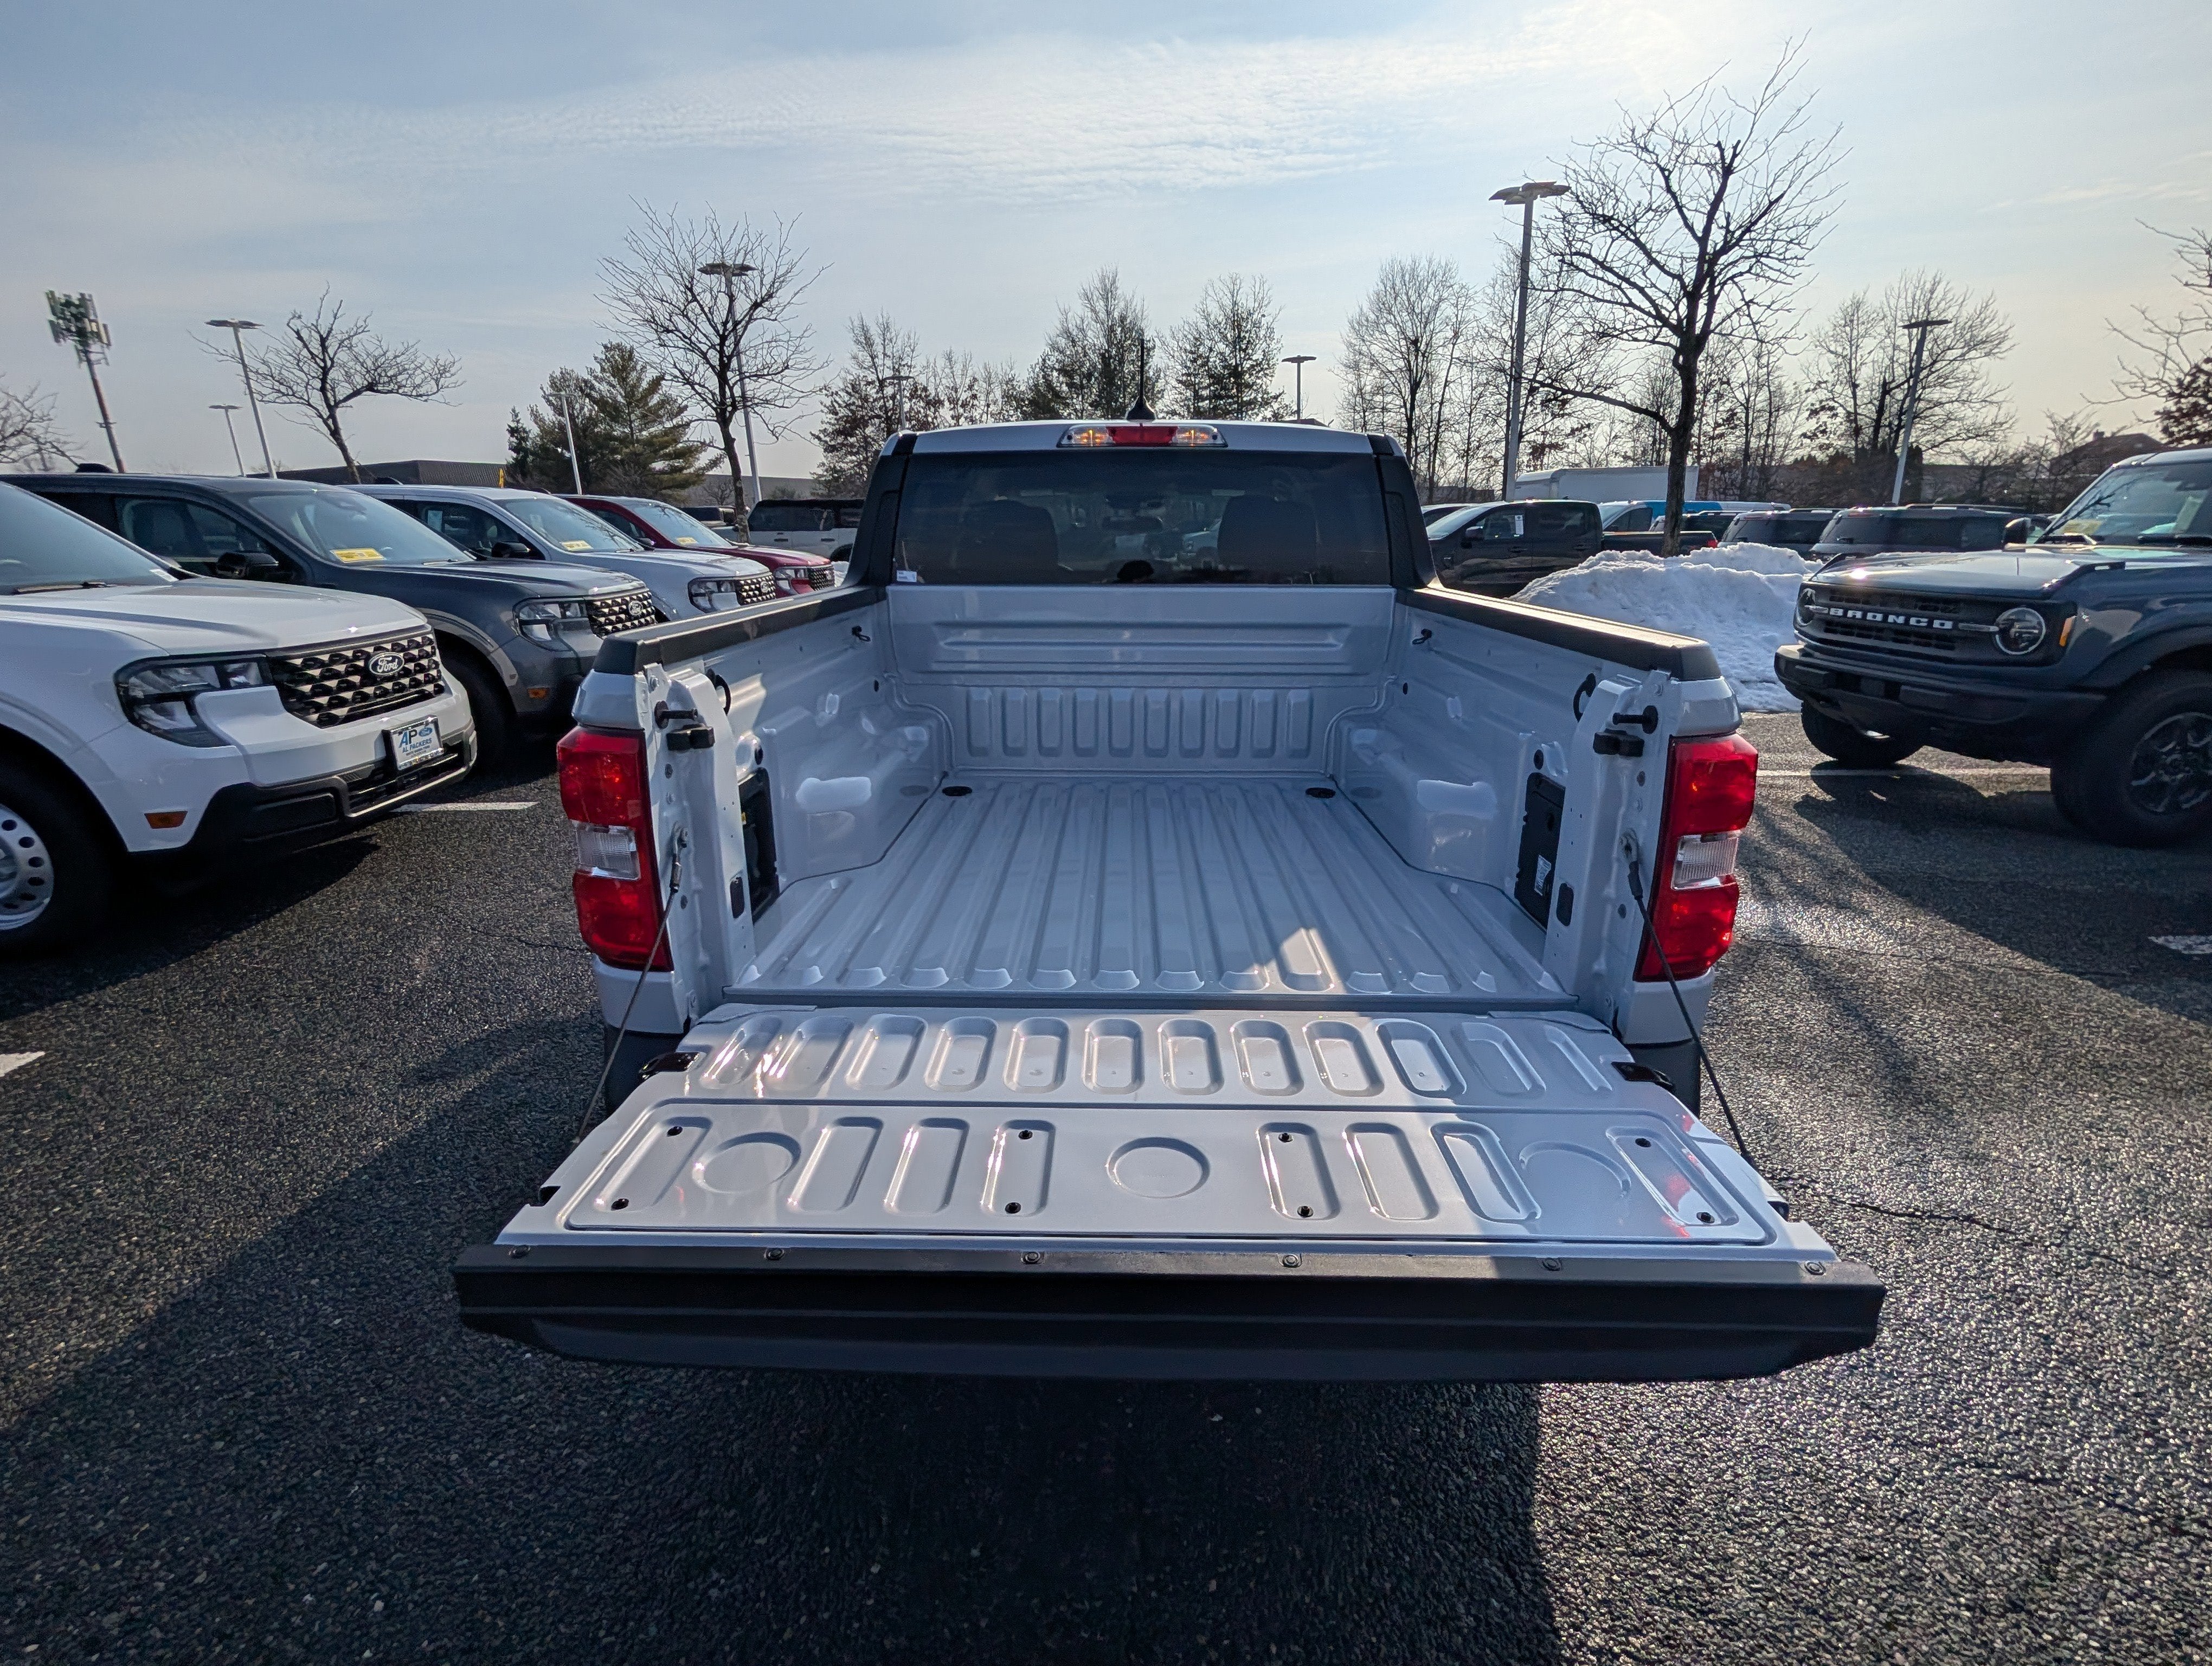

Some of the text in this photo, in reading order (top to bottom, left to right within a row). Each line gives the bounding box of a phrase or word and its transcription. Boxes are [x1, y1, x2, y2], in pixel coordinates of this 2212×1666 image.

[1829, 607, 1953, 629] BRONCO
[377, 657, 398, 672] Ford
[398, 729, 417, 748] AP
